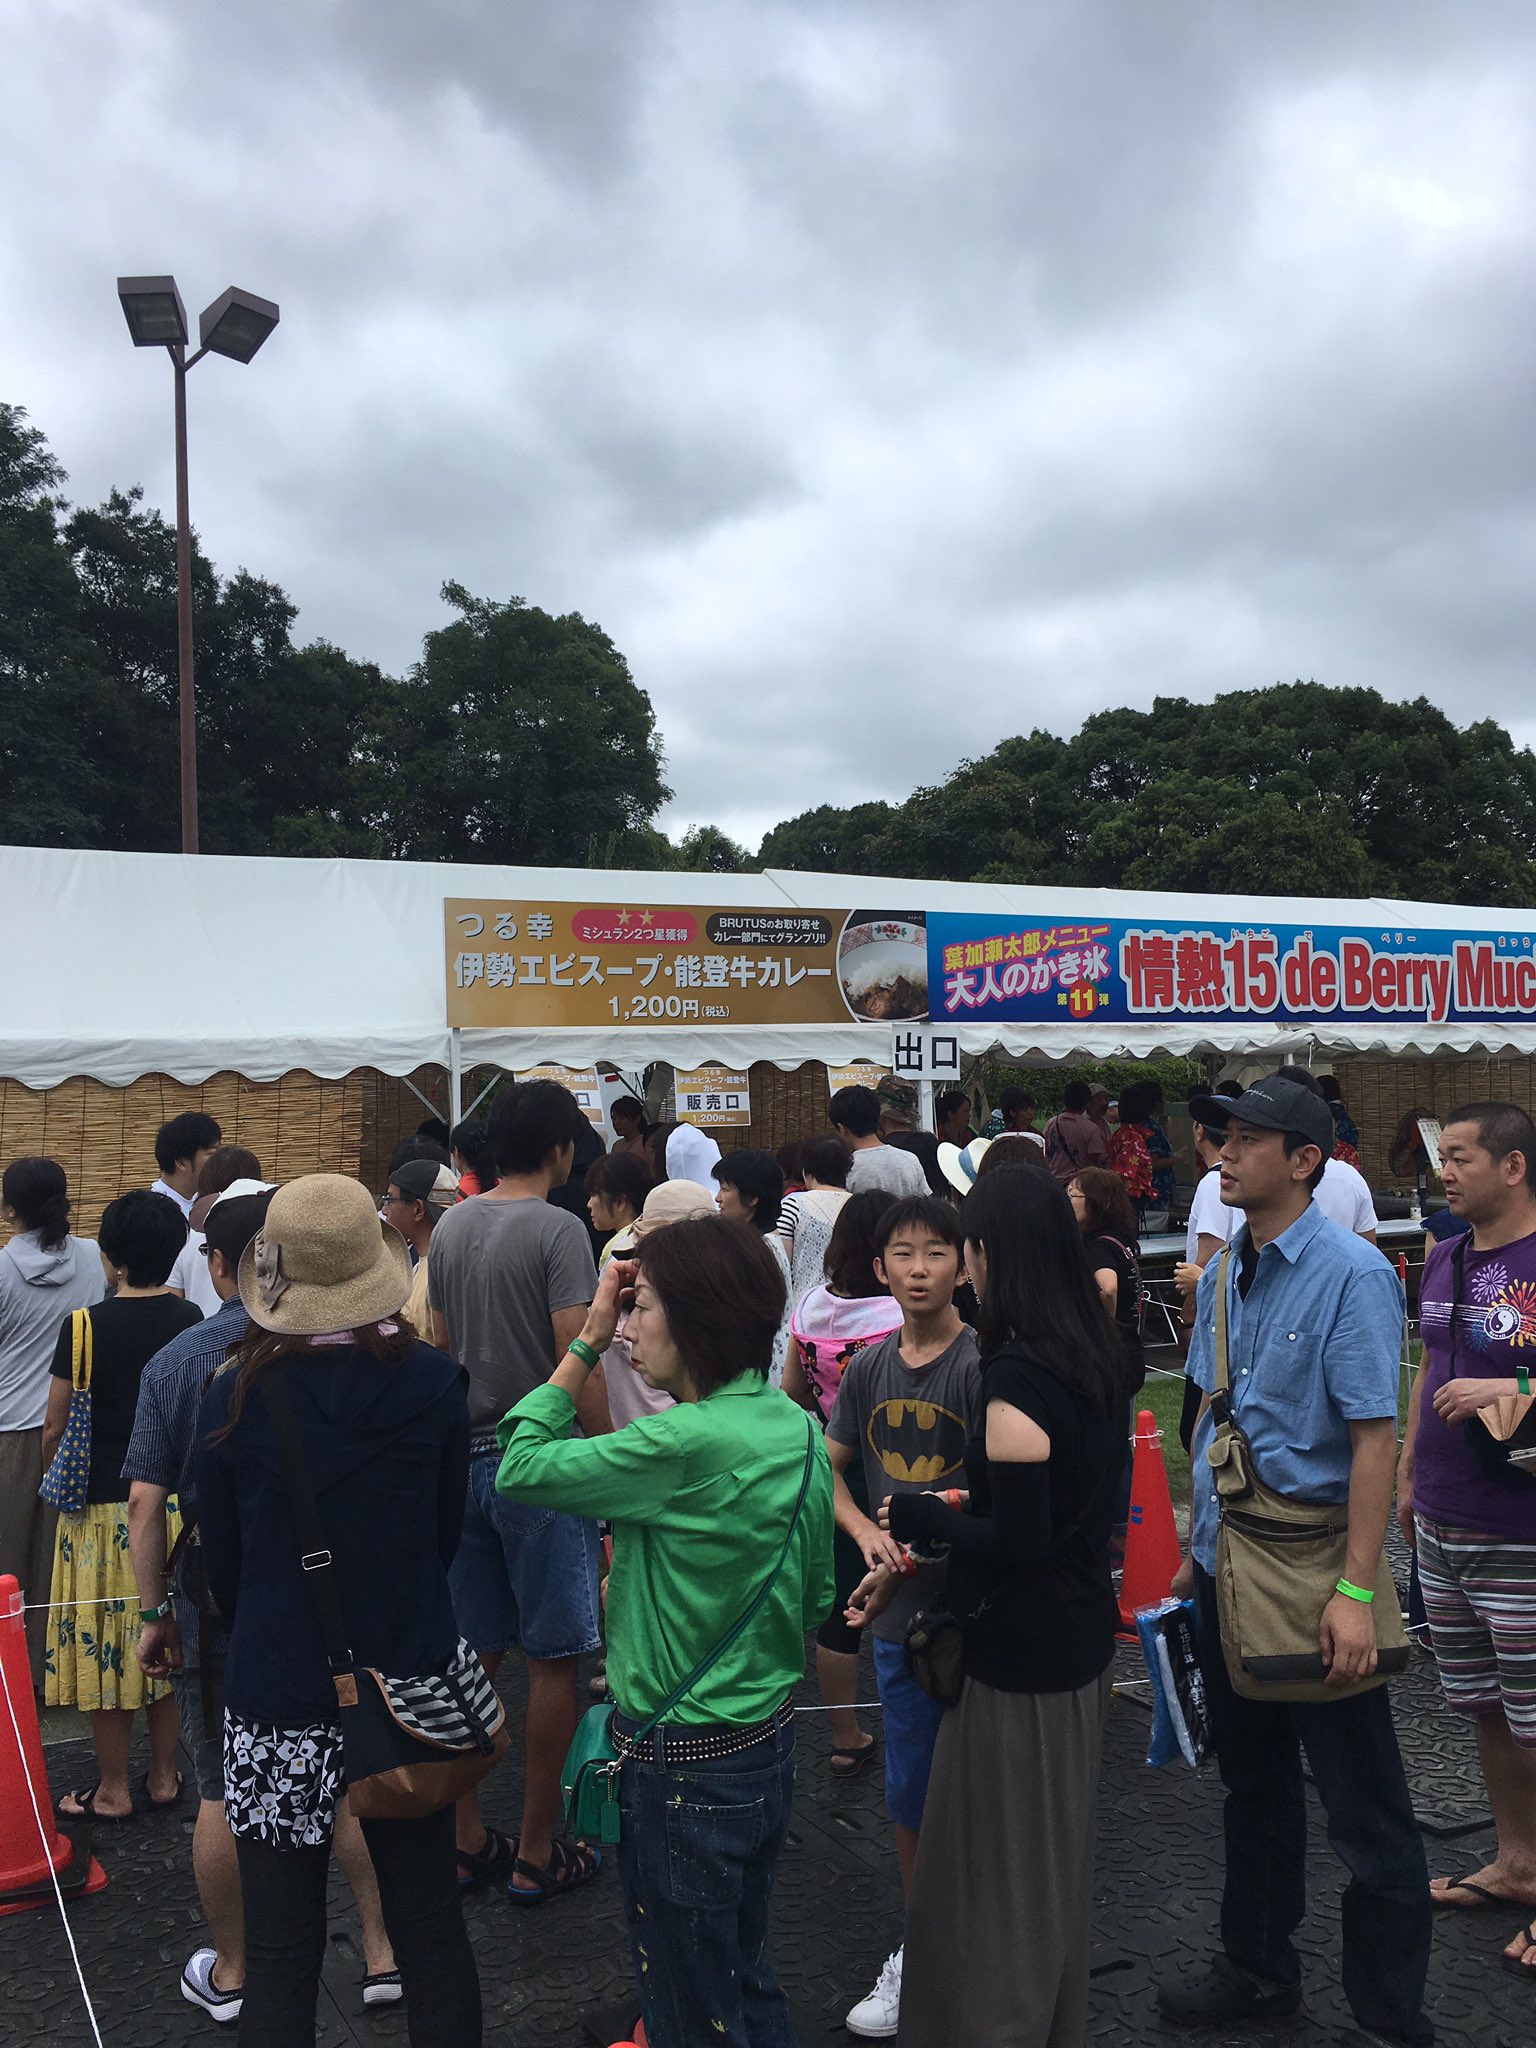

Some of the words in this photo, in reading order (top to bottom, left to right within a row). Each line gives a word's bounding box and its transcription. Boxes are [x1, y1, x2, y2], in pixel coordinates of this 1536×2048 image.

[455, 912, 553, 941] つる幸
[582, 926, 689, 941] ミシュラン2つ星獲得
[718, 917, 821, 931] BRUTUSのお取り寄せ
[1231, 929, 1270, 940] いちご
[1304, 930, 1313, 941] で
[945, 926, 1109, 972] 葉加瀬太郎メニュー
[453, 952, 832, 989] 伊勢エビスープ・能登牛カレー
[946, 945, 1109, 1010] 大人のかき氷
[1285, 941, 1337, 1008] de
[1343, 942, 1450, 1021] Berry
[894, 1031, 958, 1072] 出口
[686, 1093, 740, 1111] 販売口
[703, 1084, 723, 1092] カレー
